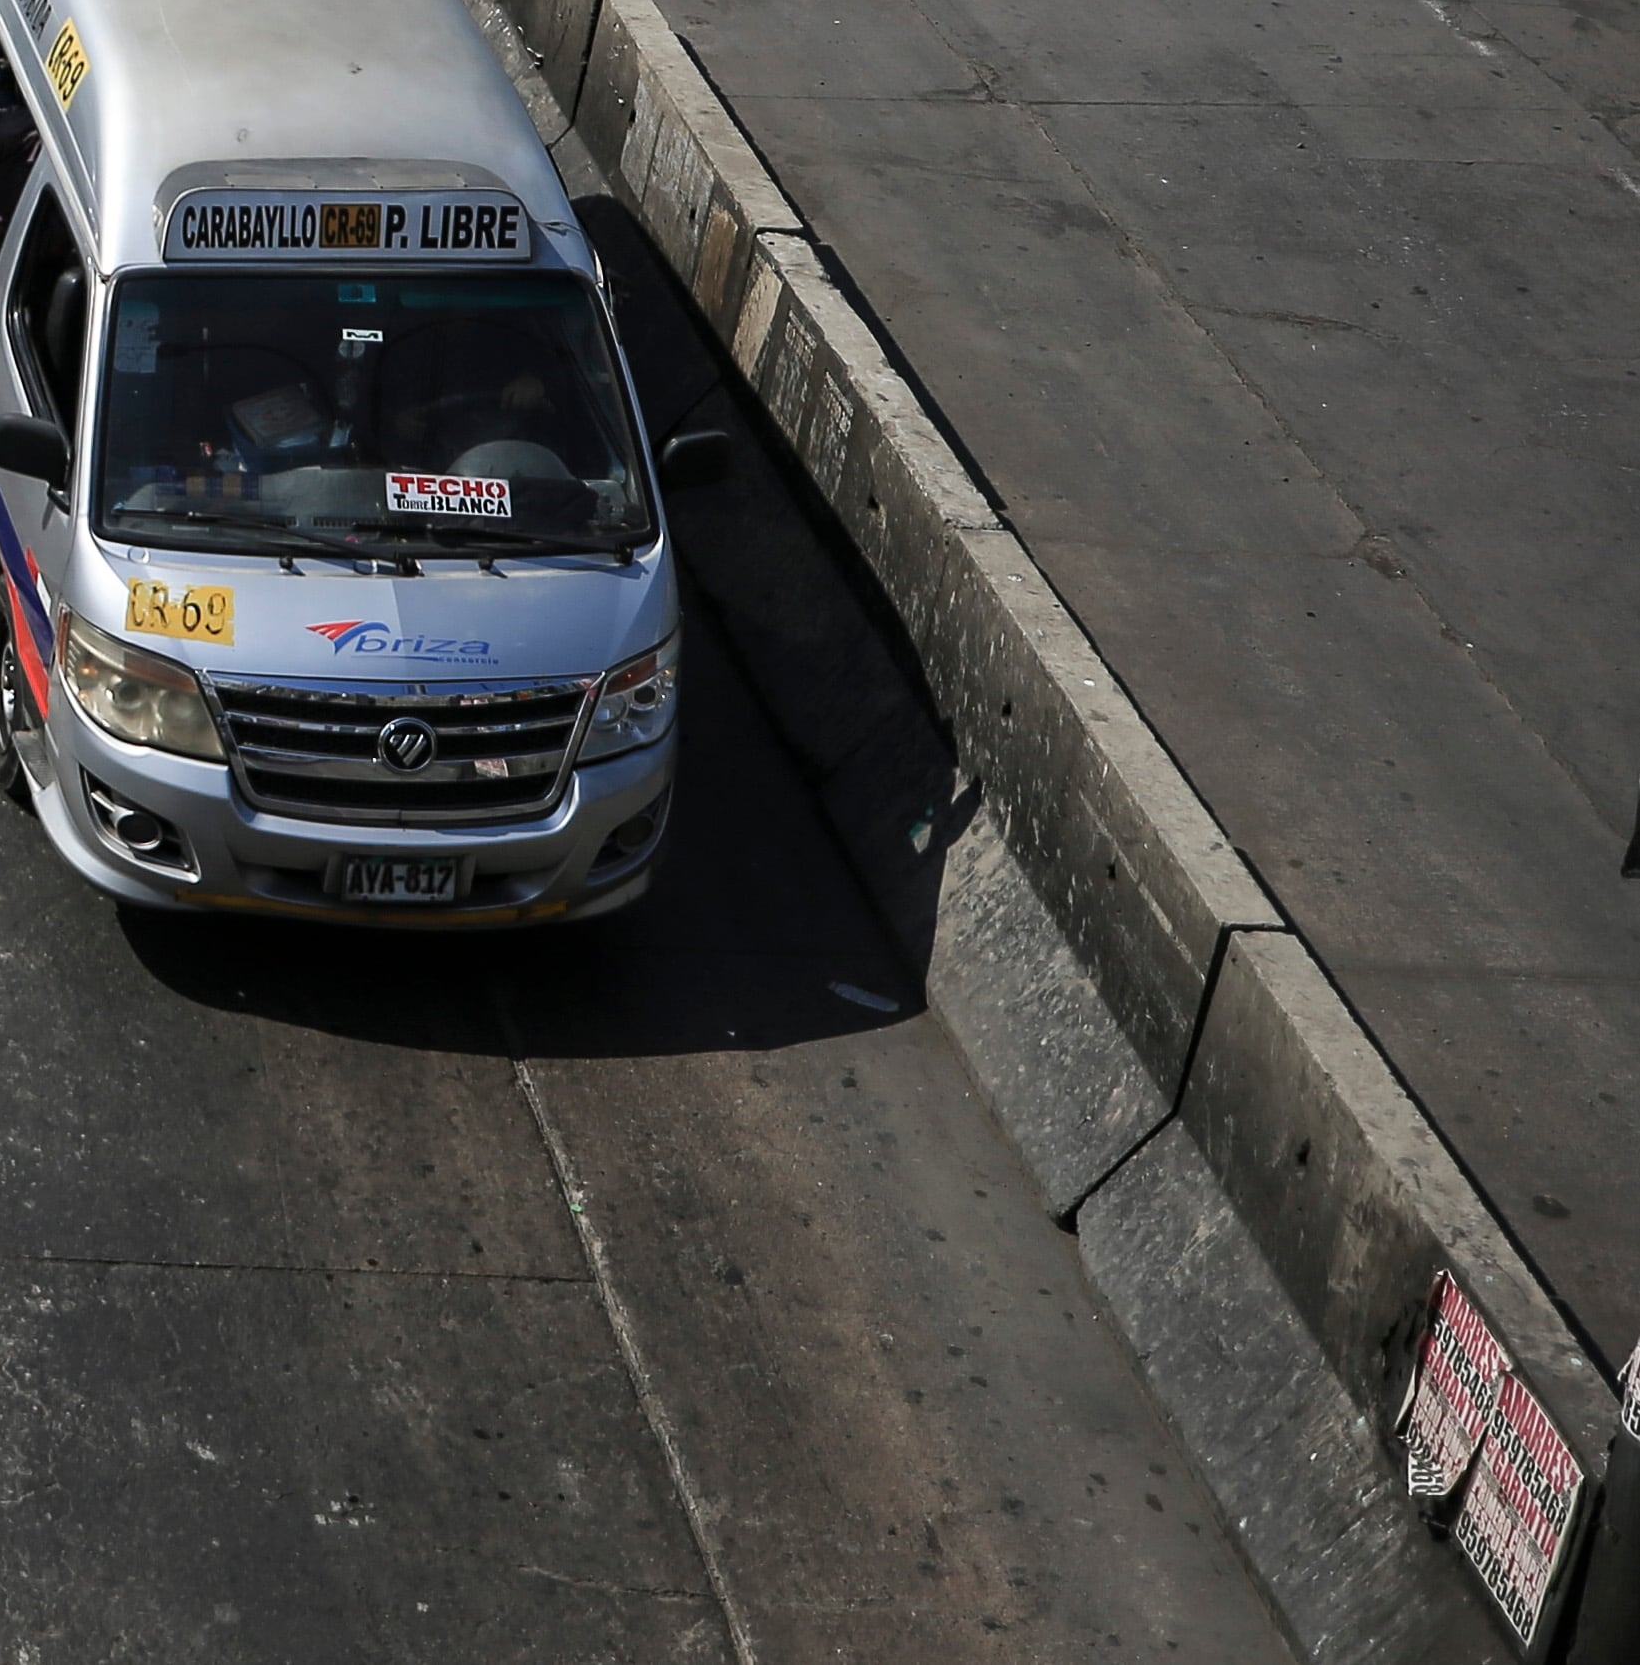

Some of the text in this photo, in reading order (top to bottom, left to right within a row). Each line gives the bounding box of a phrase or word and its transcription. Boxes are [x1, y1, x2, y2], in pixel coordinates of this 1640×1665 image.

[182, 203, 520, 249] CARABAYLLO CR-69 P. LIBRE
[391, 476, 506, 499] TECHO
[431, 495, 509, 516] BLANCA
[131, 582, 226, 635] CR-69
[354, 634, 491, 656] briza
[348, 864, 453, 894] AYA-817
[1434, 1318, 1495, 1422] 59785468
[1440, 1279, 1498, 1384] MARRES
[1491, 1409, 1567, 1535] 959785468
[1498, 1374, 1570, 1496] AMARRES
[1492, 1448, 1559, 1564] GARANTIA
[1458, 1508, 1534, 1640] 959785468
